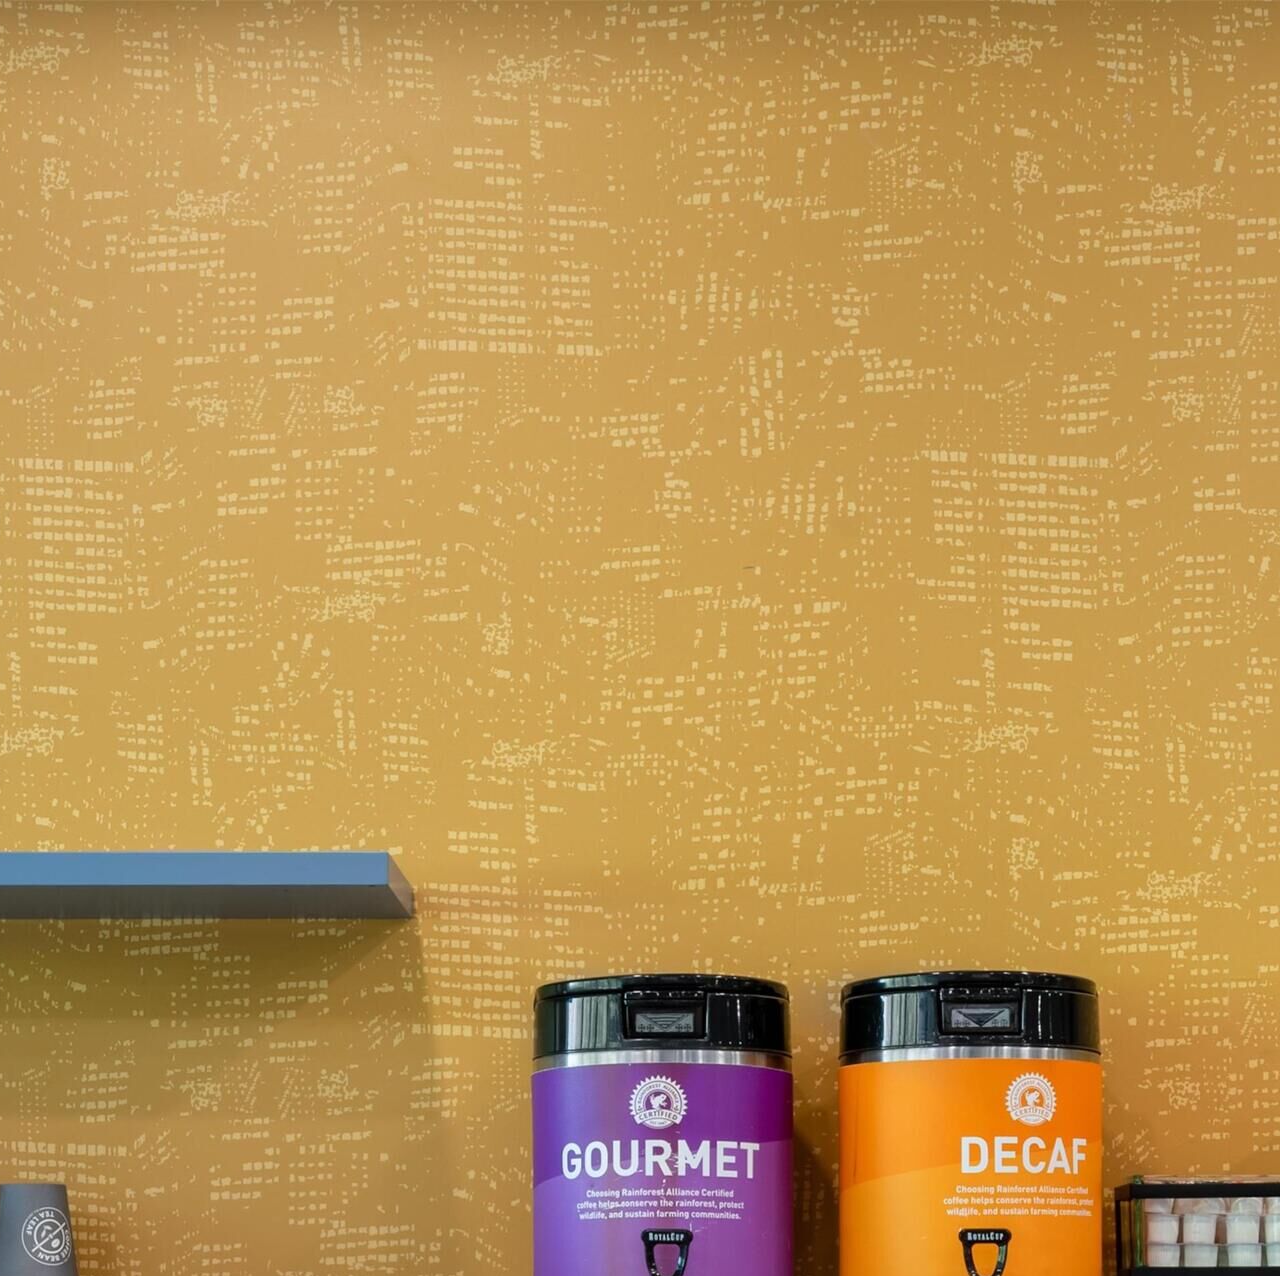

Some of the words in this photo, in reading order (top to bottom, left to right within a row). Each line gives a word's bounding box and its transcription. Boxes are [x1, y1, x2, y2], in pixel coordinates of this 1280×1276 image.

[562, 1139, 760, 1180] GOURMET
[961, 1136, 1087, 1175] DECAF
[586, 1189, 620, 1199] Choosing
[621, 1188, 665, 1197] Rainforest
[666, 1188, 700, 1197] Alliance
[701, 1188, 734, 1198] Certified
[956, 1184, 995, 1195] Choosing
[996, 1184, 1037, 1194] Rainforest
[1038, 1185, 1066, 1194] Alliance
[576, 1201, 597, 1209] coffee
[598, 1200, 620, 1210] helps
[620, 1200, 658, 1208] conserve
[660, 1199, 674, 1207] the
[675, 1199, 718, 1209] rainforest,
[719, 1201, 744, 1210] protect
[943, 1196, 969, 1205] coffee
[970, 1196, 994, 1206] helps
[995, 1197, 1032, 1205] conserve
[1033, 1196, 1045, 1205] the
[39, 1210, 55, 1219] TEA
[579, 1211, 608, 1220] wildlife,
[608, 1210, 623, 1219] and
[624, 1210, 655, 1218] sustain
[656, 1210, 690, 1220] farming
[690, 1211, 742, 1220] communities.
[982, 1207, 998, 1216] and
[1000, 1207, 1030, 1216] sustain
[1030, 1207, 1058, 1217] farming
